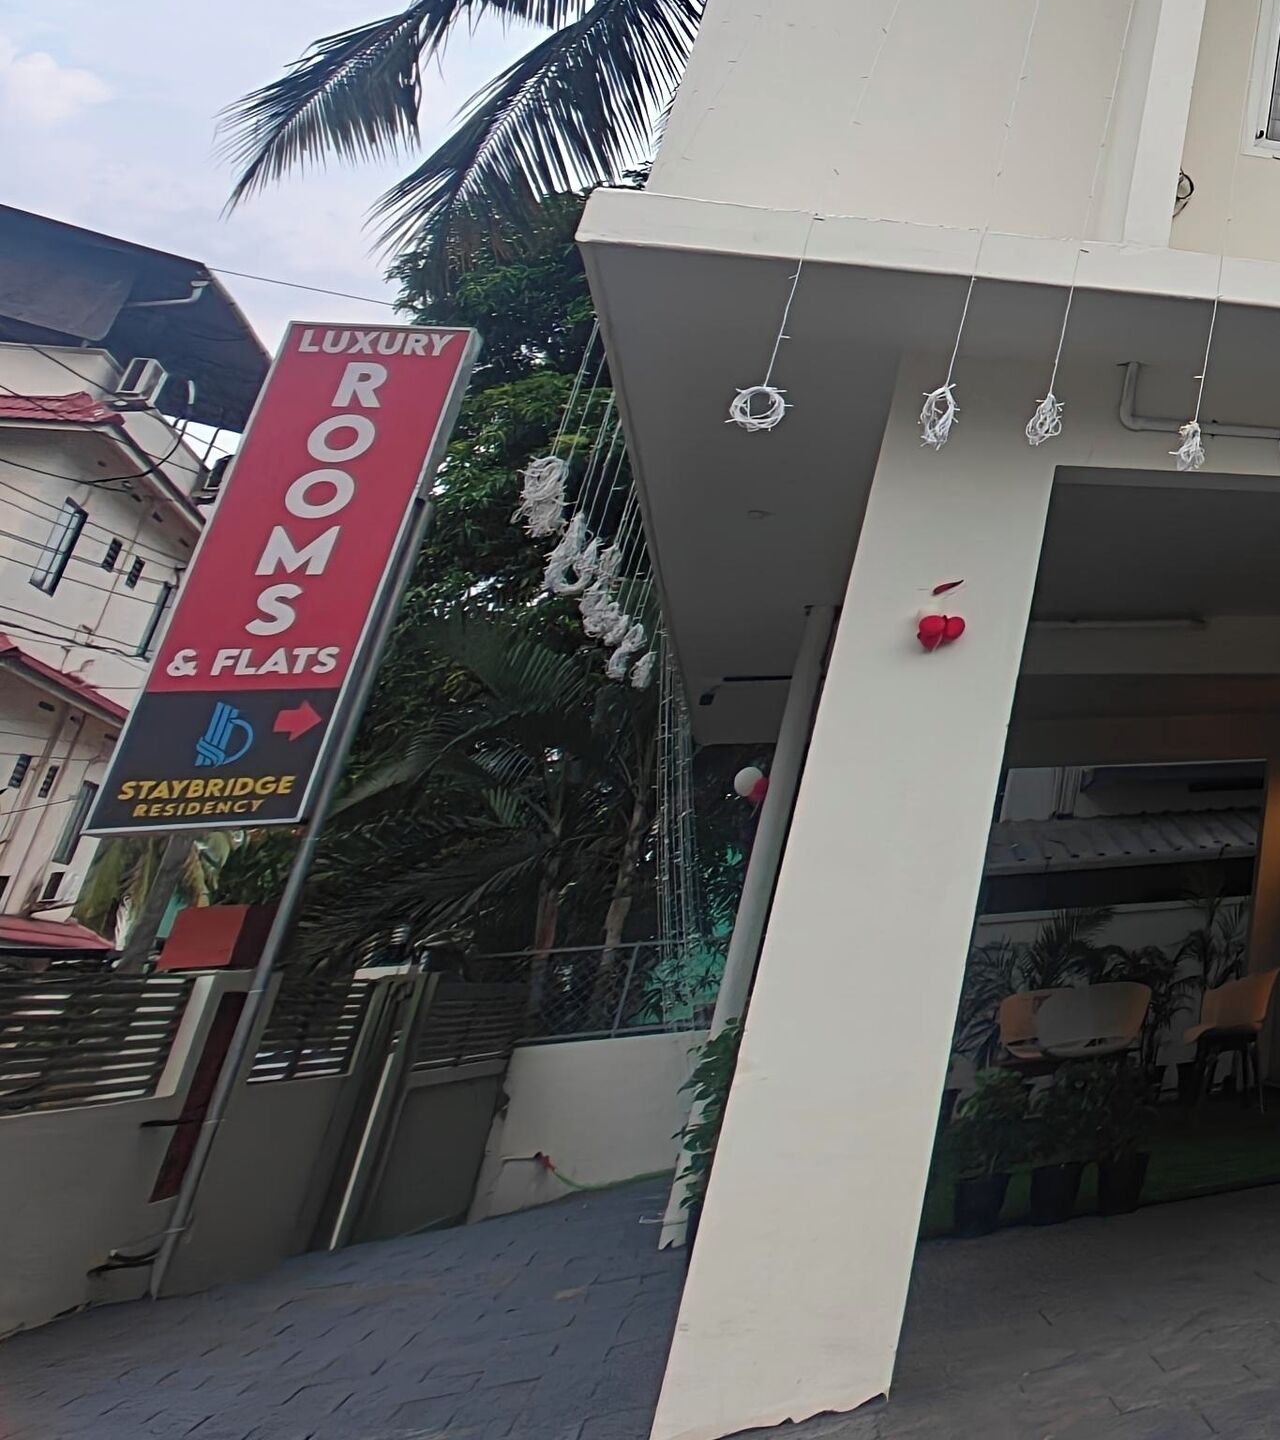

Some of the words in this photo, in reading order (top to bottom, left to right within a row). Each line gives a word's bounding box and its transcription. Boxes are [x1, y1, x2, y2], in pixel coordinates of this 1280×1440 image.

[297, 329, 455, 357] LUXURY
[244, 361, 388, 637] ROOMS
[165, 648, 198, 677] &
[209, 645, 340, 676] FLATS
[117, 775, 296, 800] STAYBRIDGE
[132, 799, 266, 817] RESIDENCY
